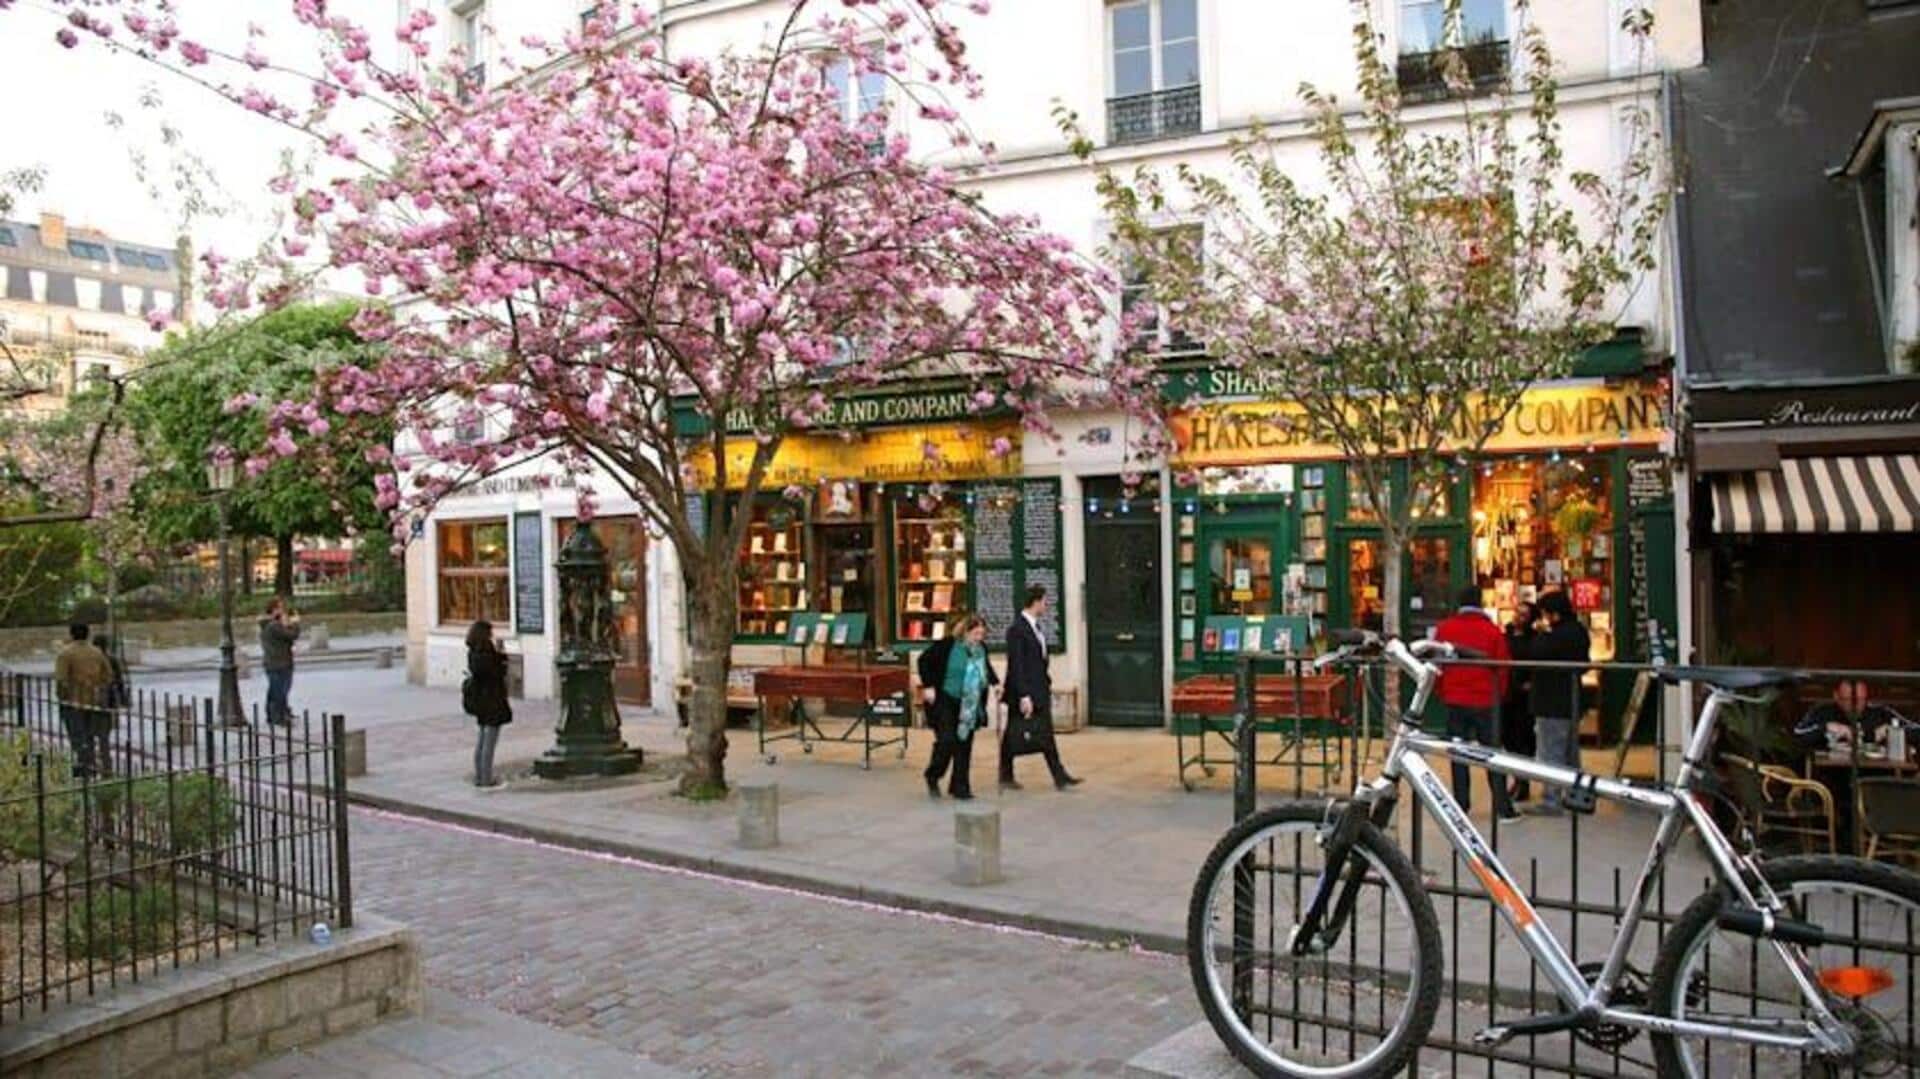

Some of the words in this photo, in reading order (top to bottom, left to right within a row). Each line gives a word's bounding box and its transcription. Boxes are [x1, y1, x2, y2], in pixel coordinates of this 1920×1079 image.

[841, 399, 879, 424] AND
[884, 392, 975, 421] COMPANY
[1514, 394, 1666, 437] COMPANY
[1769, 400, 1920, 426] Restaurant
